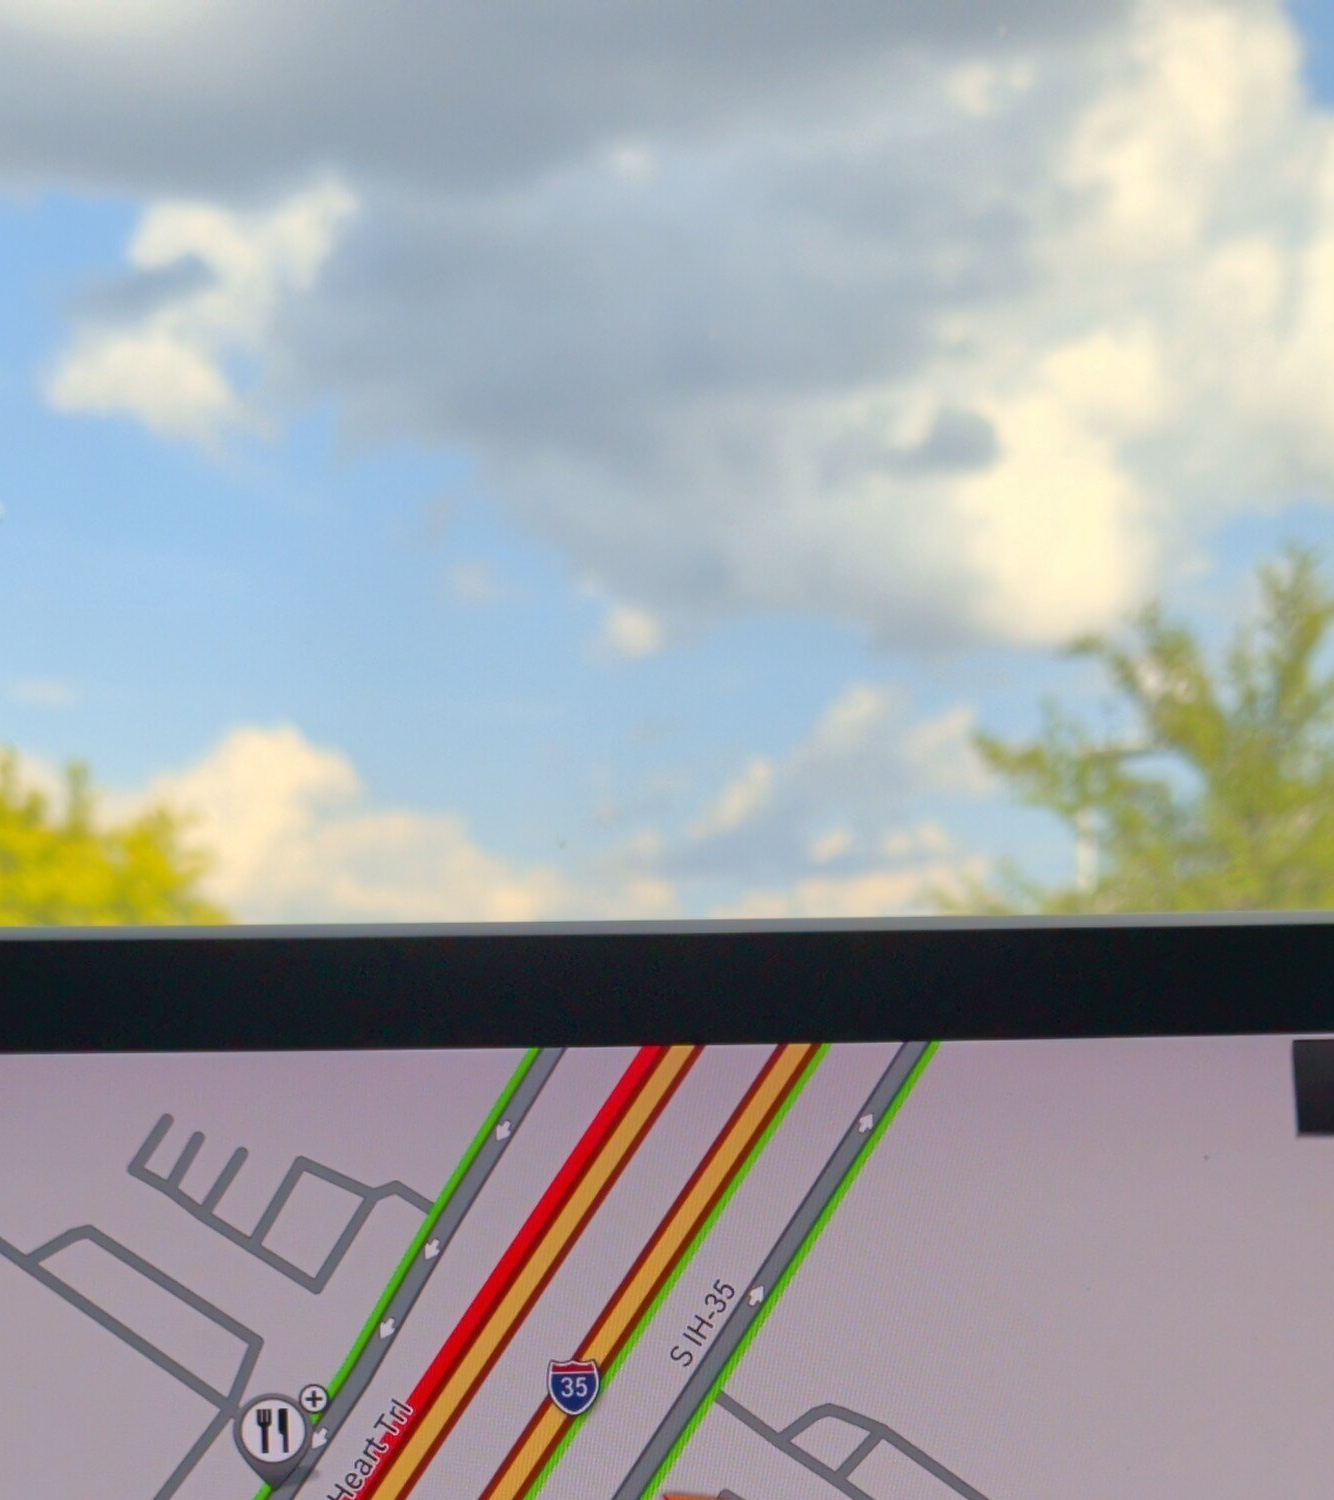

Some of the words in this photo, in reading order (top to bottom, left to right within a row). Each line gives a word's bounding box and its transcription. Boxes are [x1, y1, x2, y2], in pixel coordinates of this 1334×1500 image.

[670, 1345, 694, 1368] S
[682, 1278, 735, 1347] IH-35
[560, 1376, 588, 1398] 35
[373, 1398, 412, 1435] Trl
